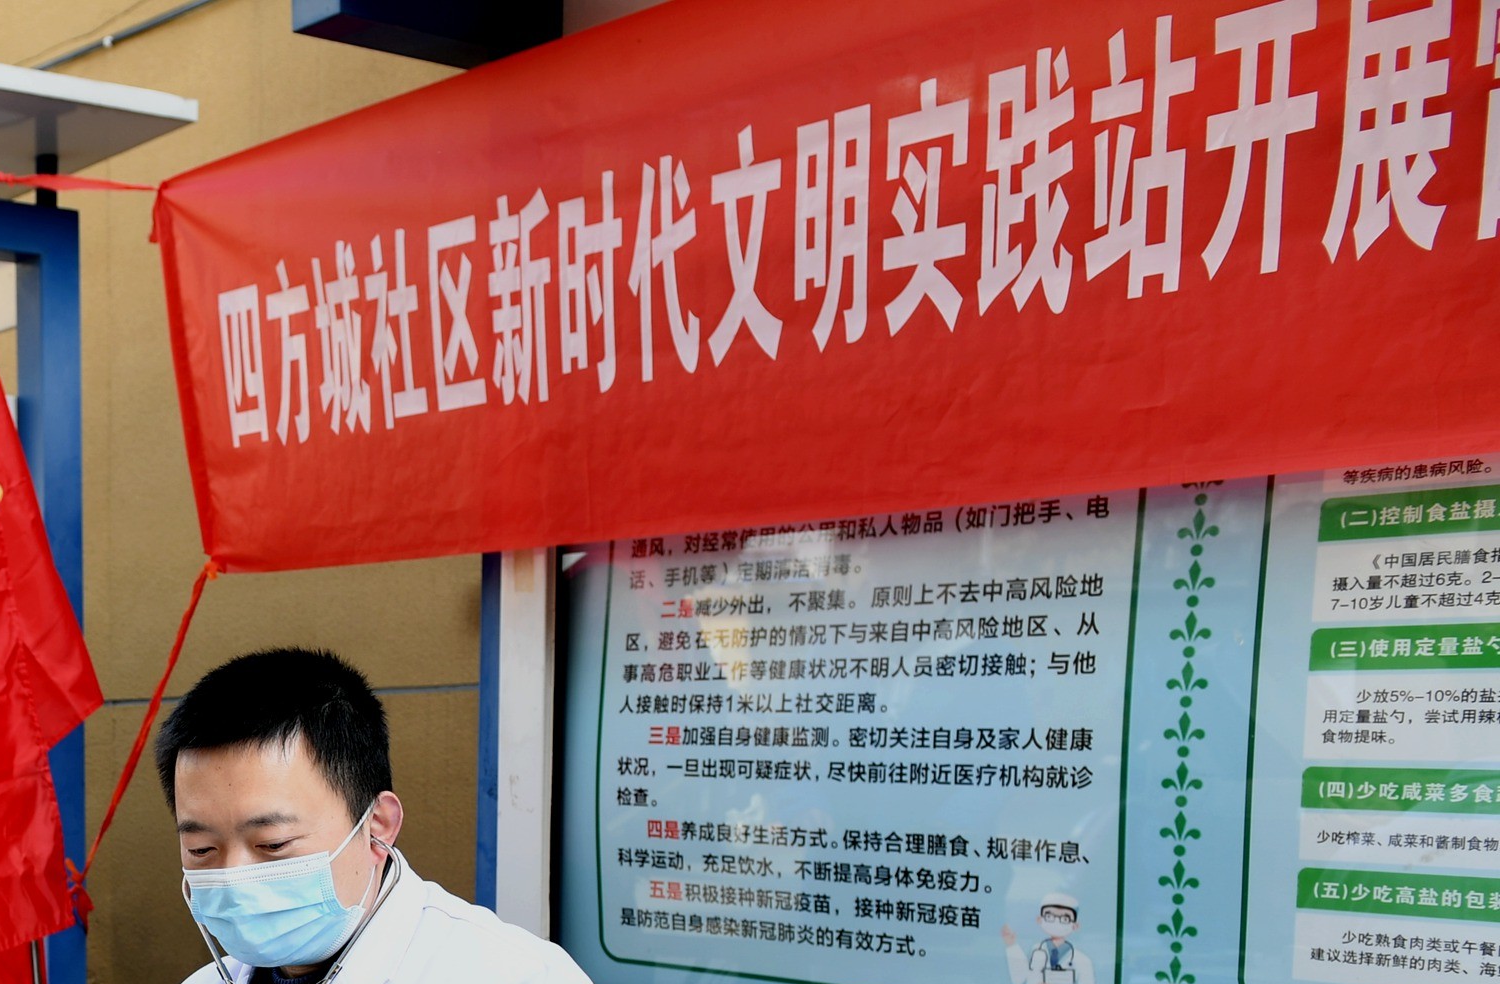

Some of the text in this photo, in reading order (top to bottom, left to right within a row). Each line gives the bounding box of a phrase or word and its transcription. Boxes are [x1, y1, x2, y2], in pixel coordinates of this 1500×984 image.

[217, 0, 1500, 448] 四方城社区新时代文明实践站开展
[1343, 458, 1493, 486] 等疾病的患病风险。
[1340, 498, 1500, 529] (二)控制食盐摄
[619, 691, 889, 715] 人接触时保持1米以上社交距离。
[1356, 687, 1500, 705] 少放5%-10%的盐
[1322, 708, 1500, 726] 用定量盐勺，尝试用辣
[648, 725, 1094, 752] 三是加强自身健康监测。密切关注自身及家人健康
[1321, 728, 1396, 745] 食物提味。
[617, 755, 1094, 789] 状况，一旦出现可疑症状，尽快前往附近医疗机构就诊
[616, 786, 658, 808] 检查。
[1318, 780, 1500, 803] (四)少吃咸菜多食
[647, 819, 1091, 865] 四是养成良好生活方式。保持合理膳食、规律作息、
[617, 847, 993, 894] 科学运动，充足饮水，不断提高身体免疫力。
[650, 879, 981, 929] 五是积极接种新冠疫苗，接种新冠疫苗
[620, 906, 927, 958] 是防范自身感染新冠肺炎的有效方式。
[1342, 930, 1500, 957] 少吃熟食肉类或午餐
[1309, 947, 1500, 978] 建议选择新鲜的肉类、海
